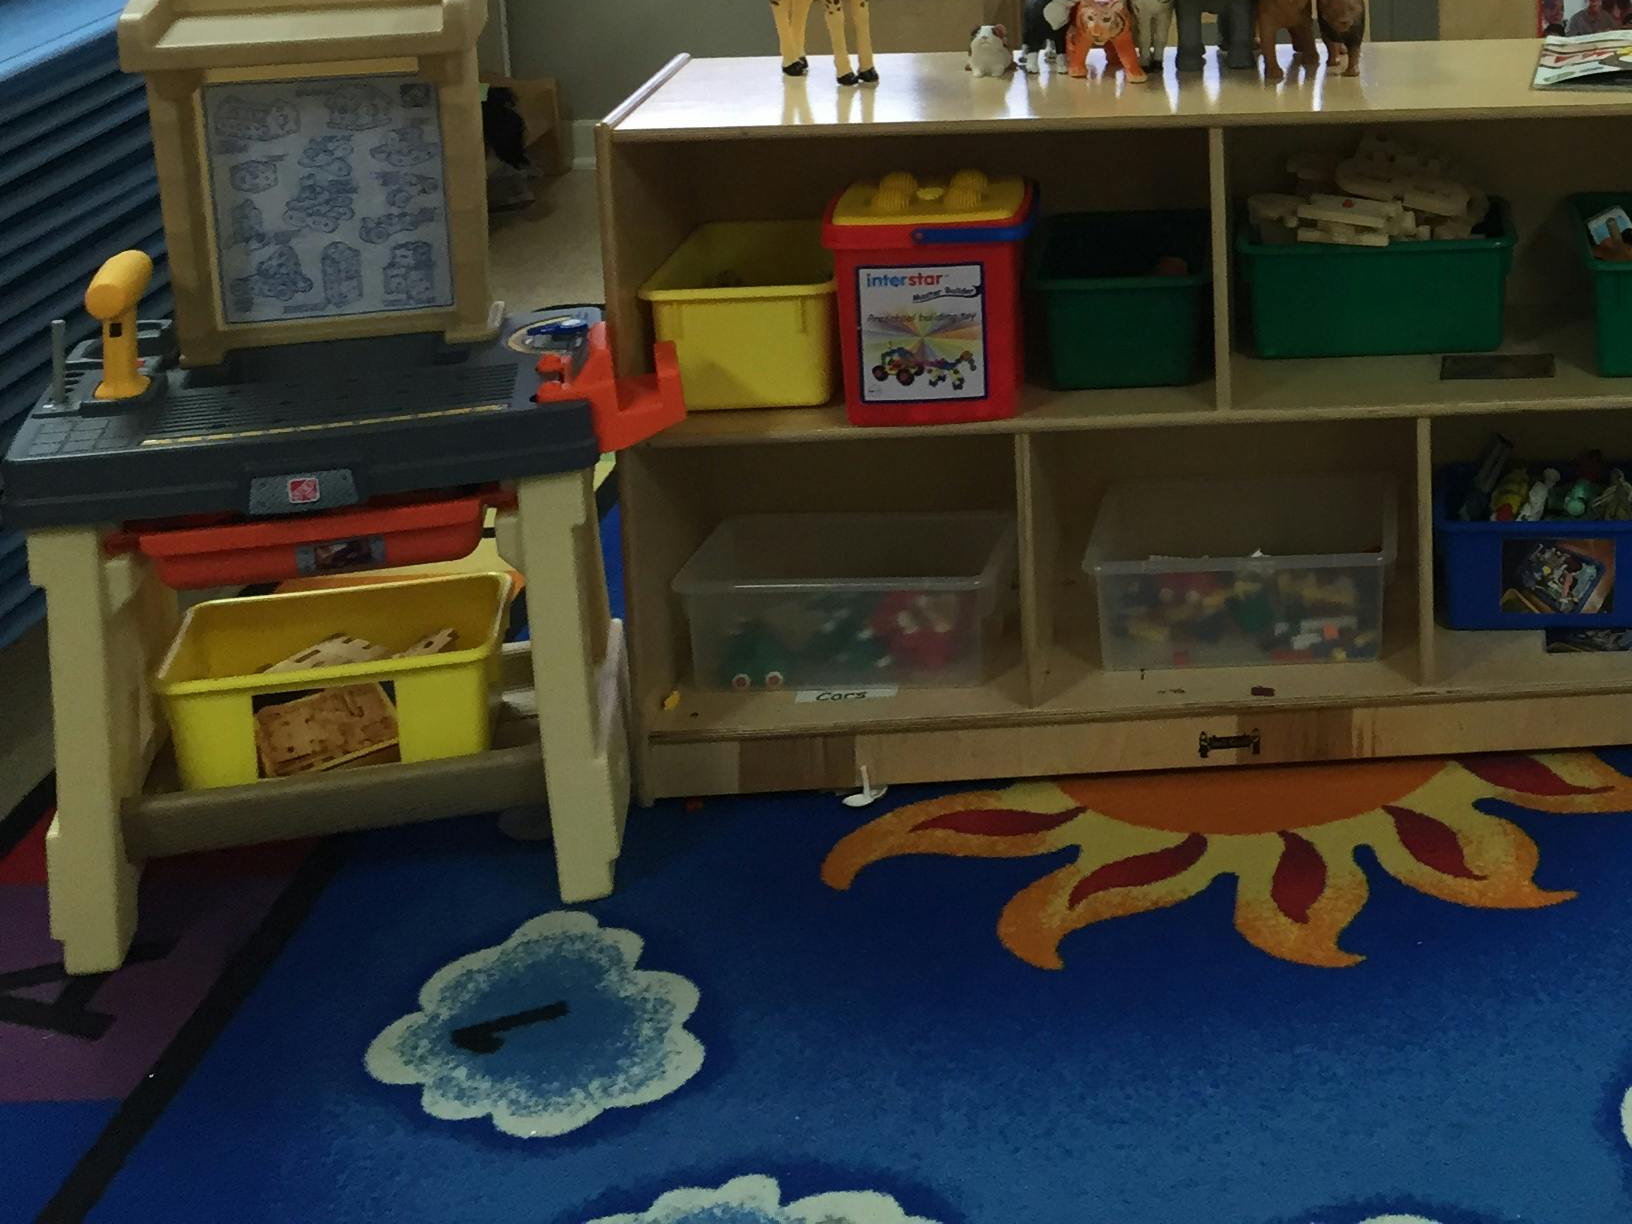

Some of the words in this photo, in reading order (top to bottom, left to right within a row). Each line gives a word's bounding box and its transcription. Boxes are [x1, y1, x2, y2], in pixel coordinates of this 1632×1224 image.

[866, 272, 944, 288] interstar
[816, 691, 868, 701] Cars
[450, 1000, 570, 1055] 1
